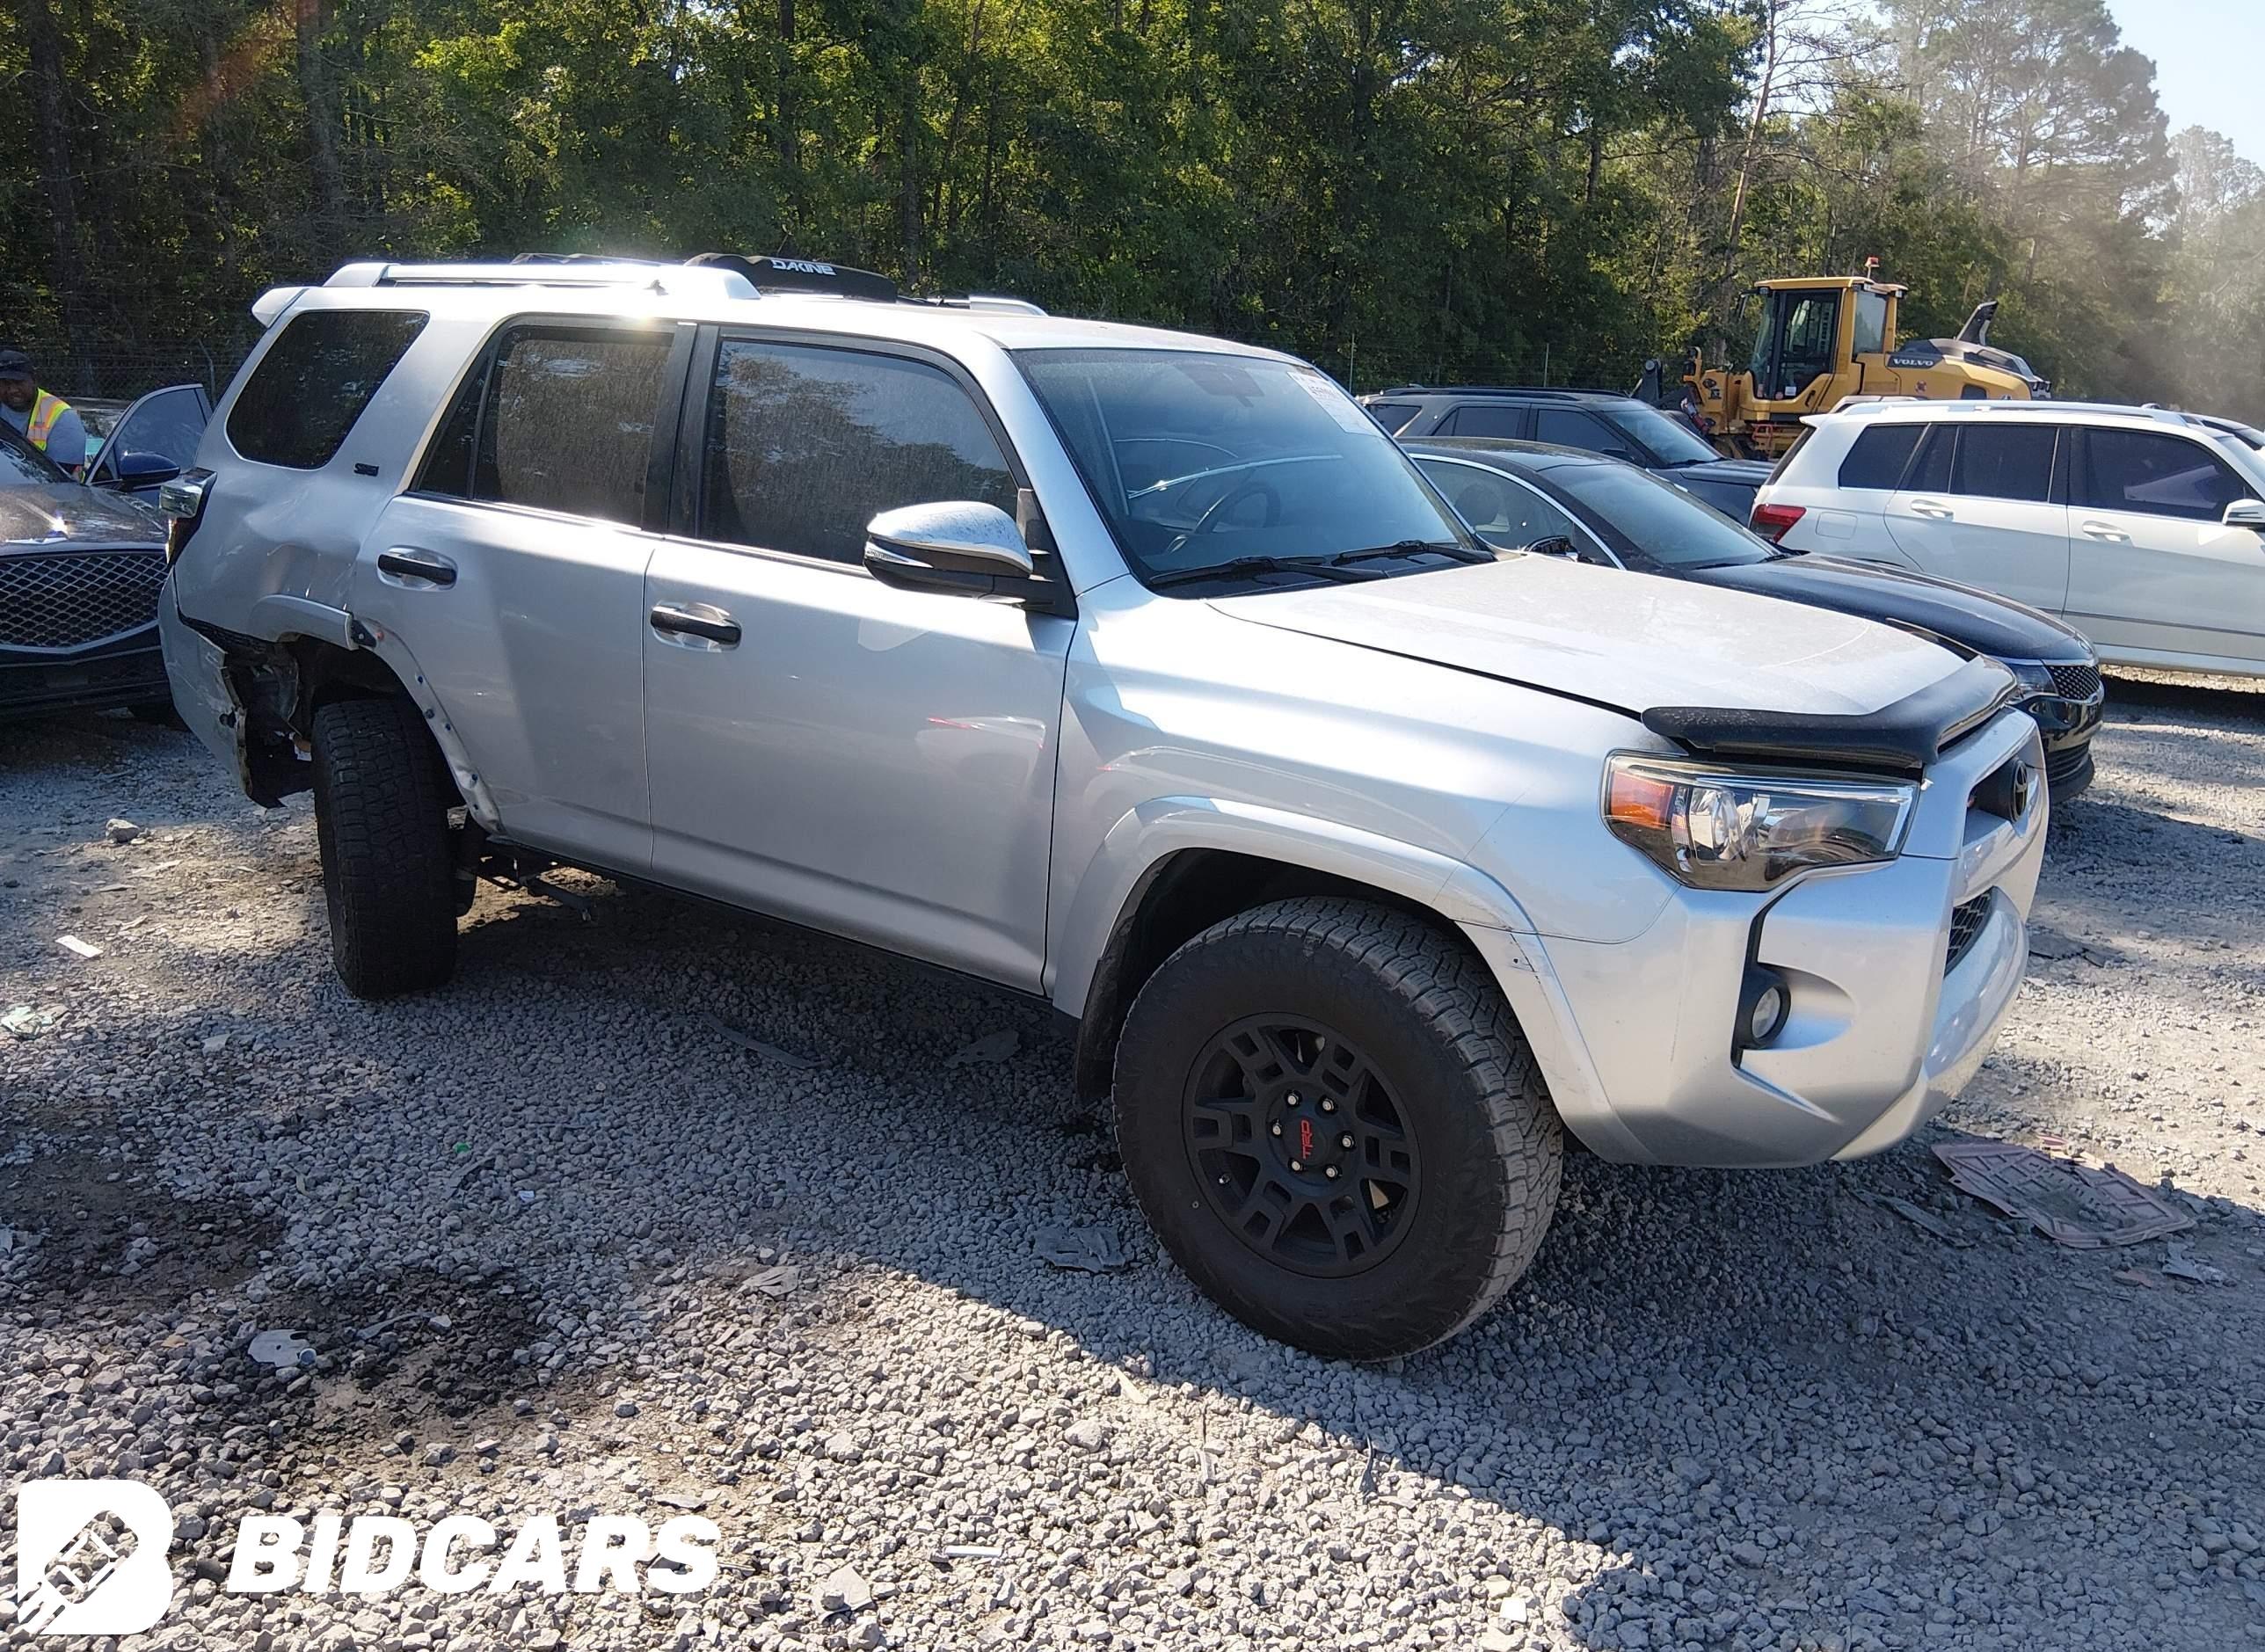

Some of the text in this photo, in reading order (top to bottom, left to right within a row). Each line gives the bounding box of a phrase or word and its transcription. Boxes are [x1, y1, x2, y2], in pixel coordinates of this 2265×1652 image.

[771, 259, 837, 276] DAKINE
[1894, 358, 1934, 368] VOLVO
[1300, 1119, 1313, 1160] TRD
